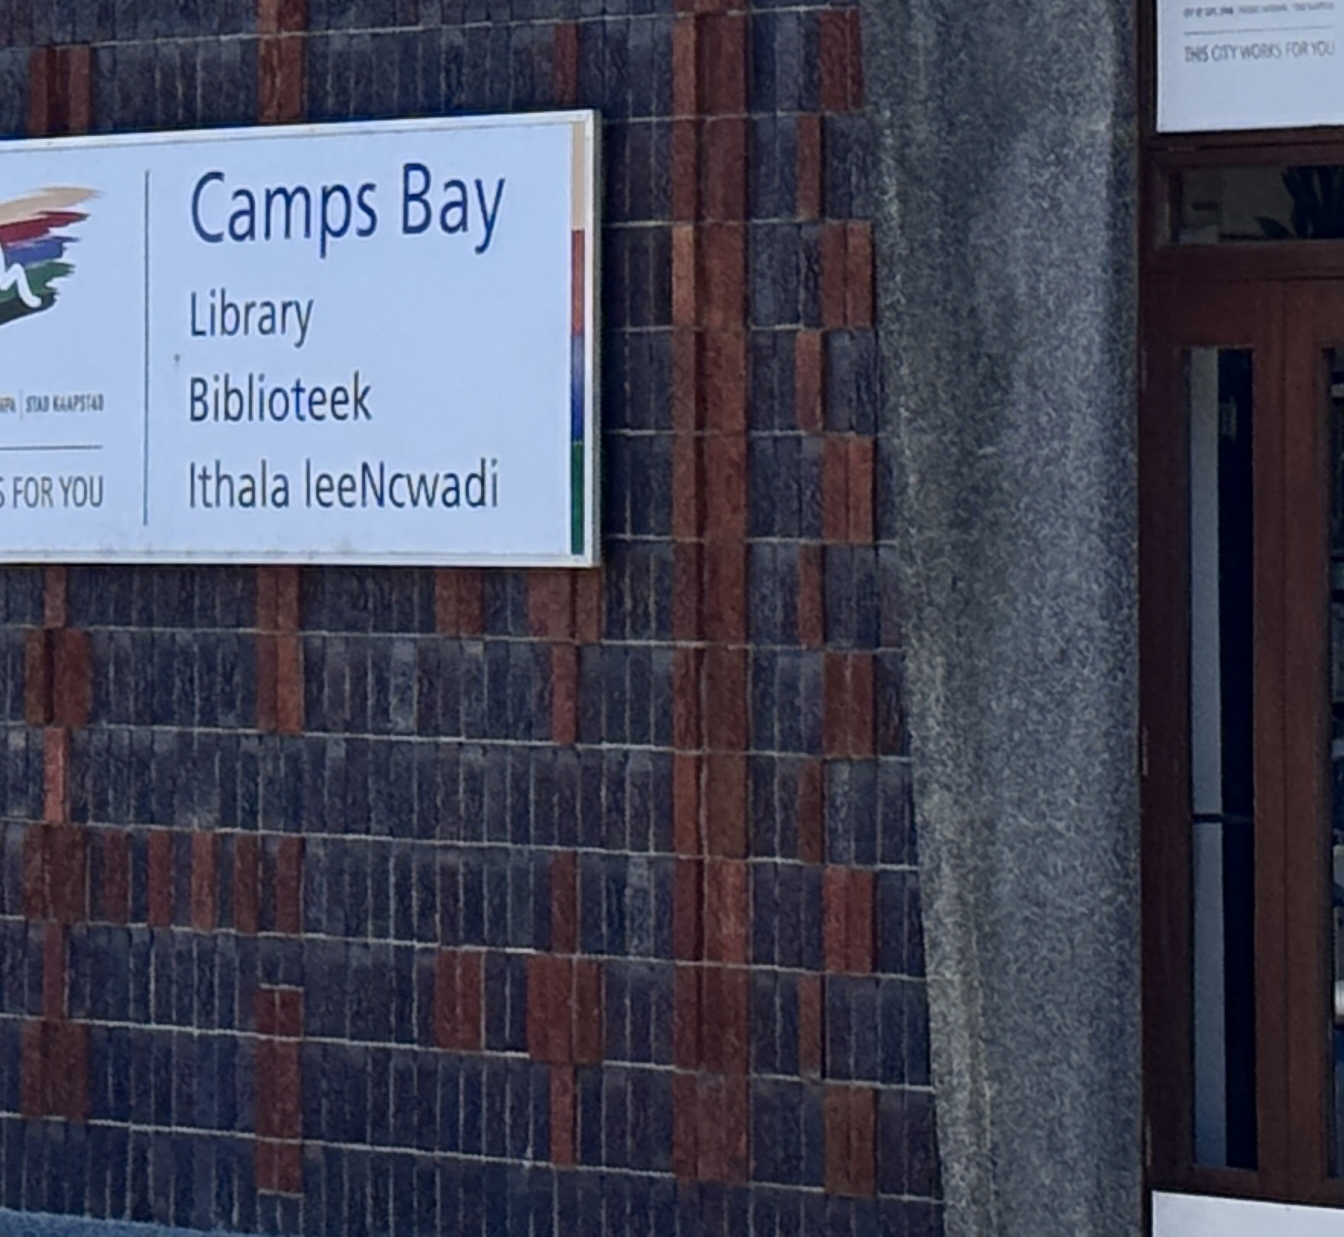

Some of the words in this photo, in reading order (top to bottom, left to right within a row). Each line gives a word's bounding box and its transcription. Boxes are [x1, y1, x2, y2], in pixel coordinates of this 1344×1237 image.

[1184, 44, 1209, 63] THIS
[1211, 44, 1237, 62] CITY
[1239, 42, 1283, 60] WORKS
[1285, 41, 1307, 58] FOR
[1310, 40, 1336, 57] YOU
[191, 170, 378, 260] Camps
[402, 162, 506, 255] Bay
[190, 287, 315, 349] Library
[25, 394, 50, 413] STAD
[189, 369, 374, 423] Biblioteek
[12, 475, 55, 509] FOR
[58, 474, 104, 508] YOU
[189, 458, 290, 509] Ithala
[305, 457, 499, 509] leeNcwadi
